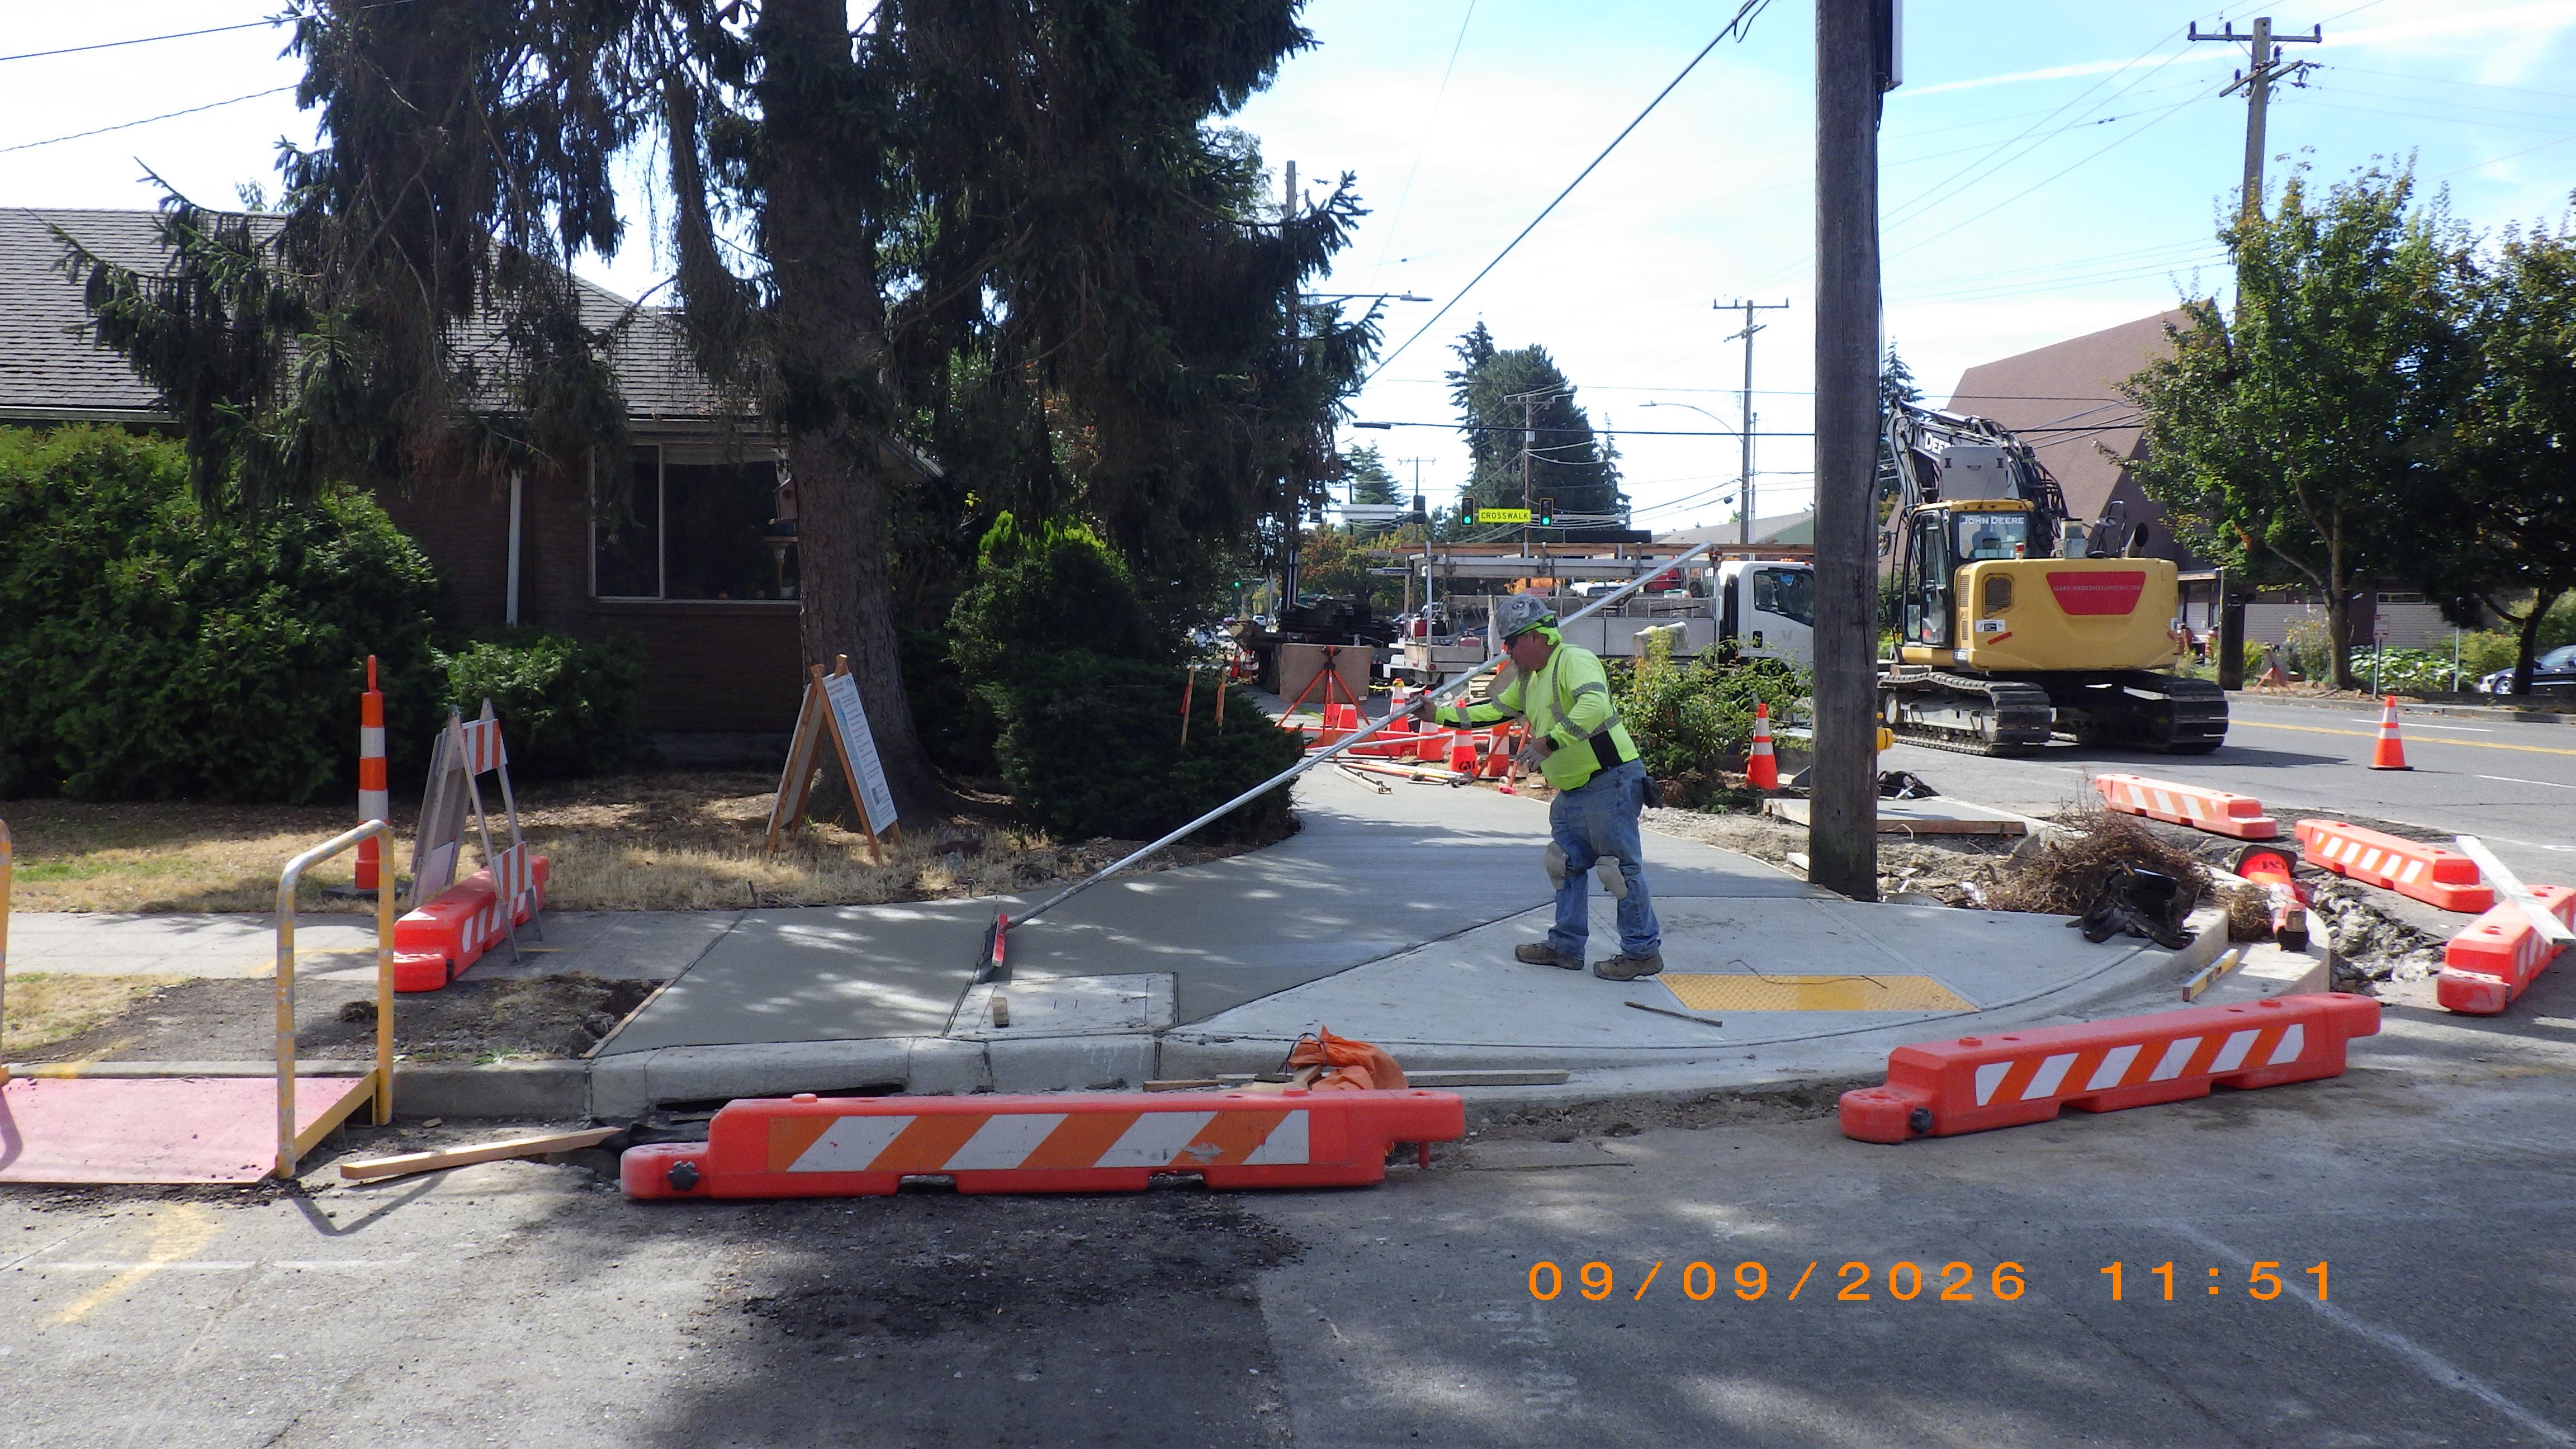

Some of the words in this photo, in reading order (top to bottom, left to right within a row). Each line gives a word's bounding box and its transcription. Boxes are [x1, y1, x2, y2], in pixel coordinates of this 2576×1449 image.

[1925, 432, 1954, 454] DEE
[1961, 515, 1989, 524] JOHN
[1991, 516, 2024, 524] DEERE
